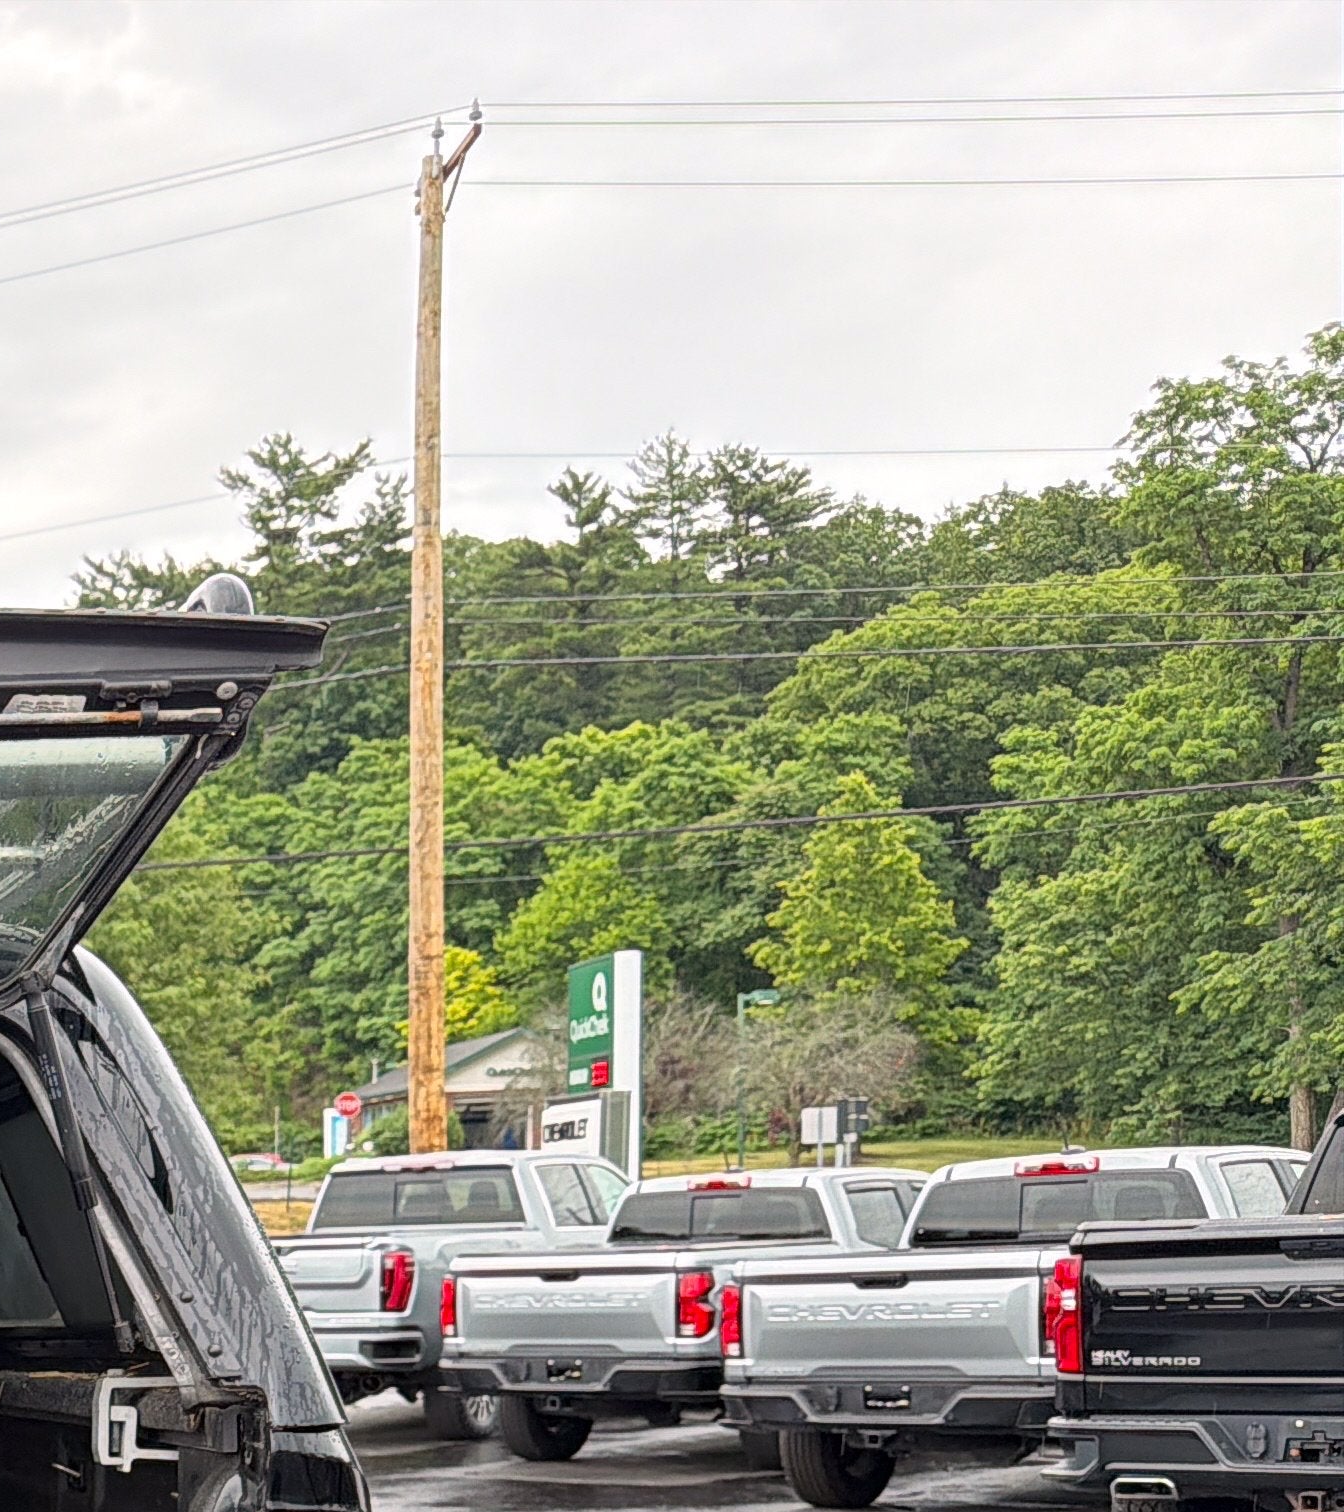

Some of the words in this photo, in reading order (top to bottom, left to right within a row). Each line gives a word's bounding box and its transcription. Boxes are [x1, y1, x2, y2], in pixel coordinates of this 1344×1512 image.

[474, 1292, 649, 1309] CHEVROLET
[767, 1301, 1001, 1322] CHEVROLET
[1091, 1356, 1201, 1366] SILVERADO
